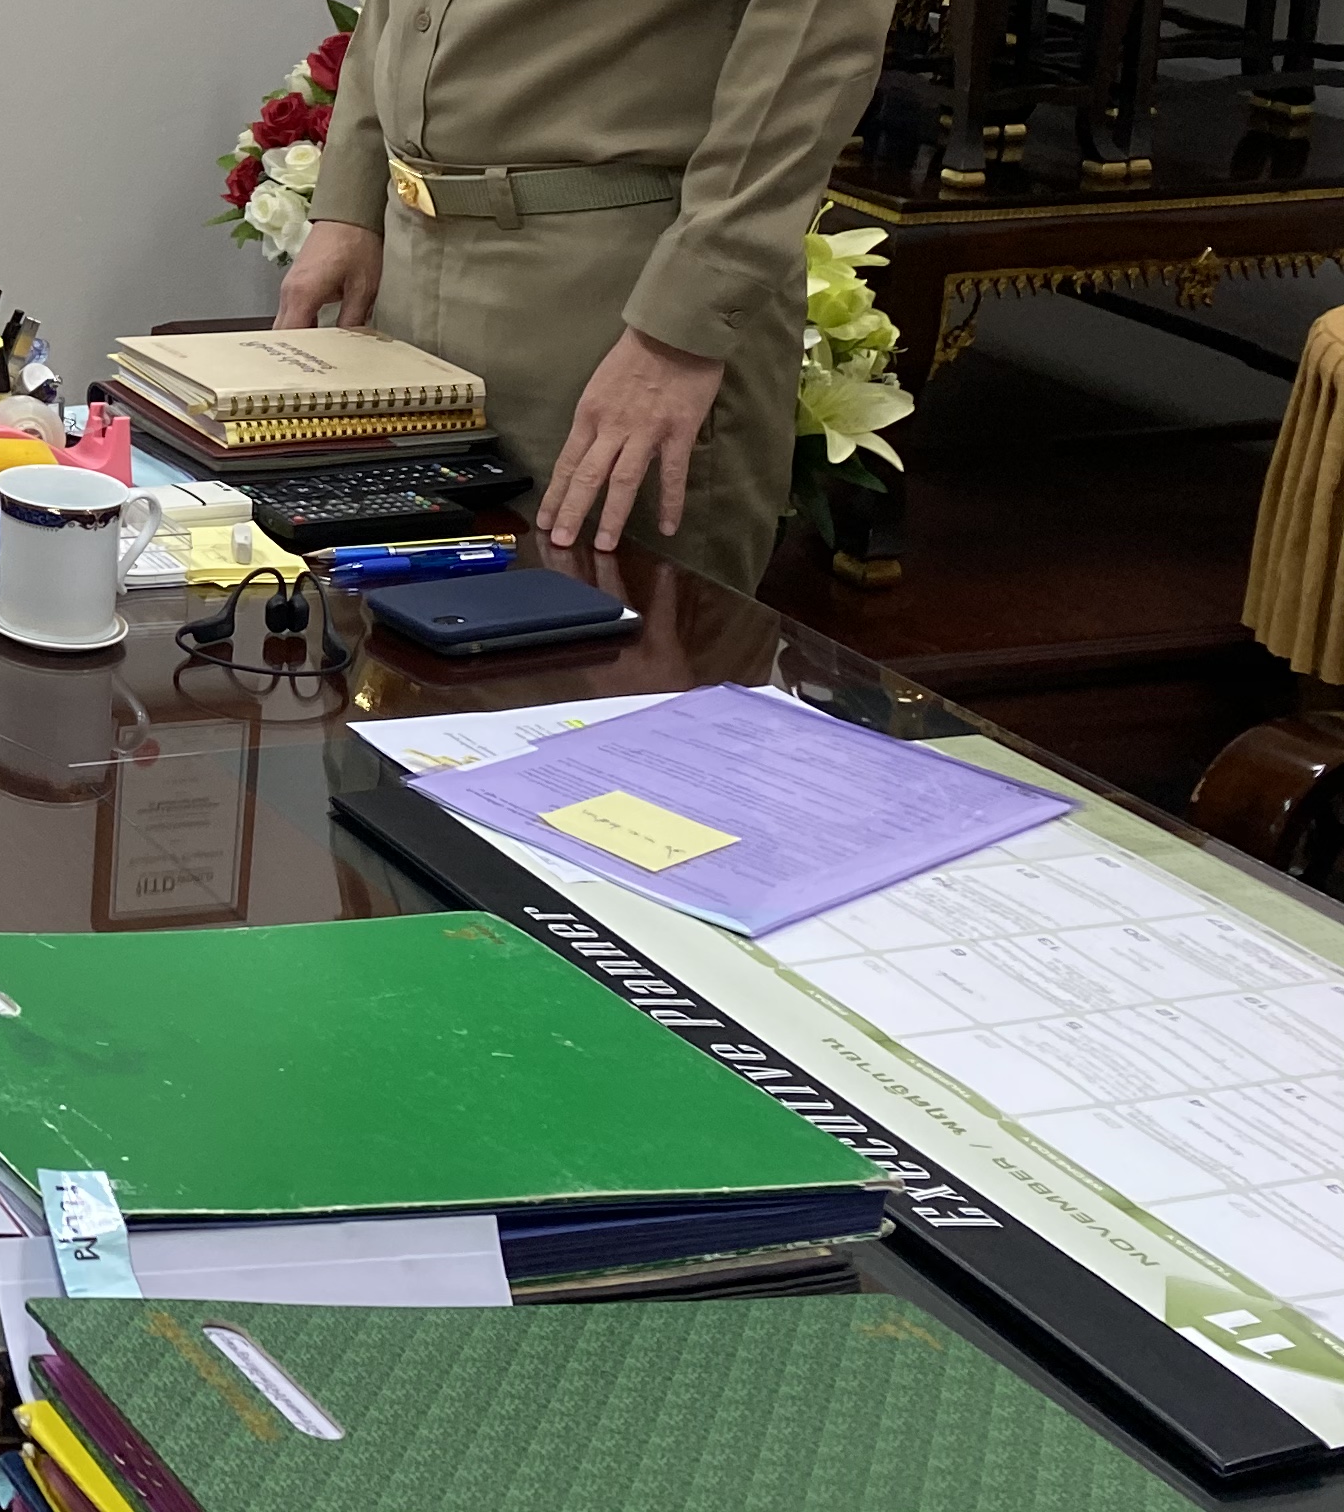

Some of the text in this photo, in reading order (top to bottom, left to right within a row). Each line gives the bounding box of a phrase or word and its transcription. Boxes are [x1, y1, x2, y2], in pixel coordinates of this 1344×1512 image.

[1037, 937, 1061, 952] 13
[523, 906, 1004, 1229] Executive Planner
[822, 1037, 967, 1136] พฤศจิกายน
[1021, 1136, 1104, 1191] WEDNESDAY
[992, 1157, 1161, 1267] NOVEMBER
[1164, 1234, 1232, 1277] TUESDAY
[1204, 1309, 1297, 1360] 11
